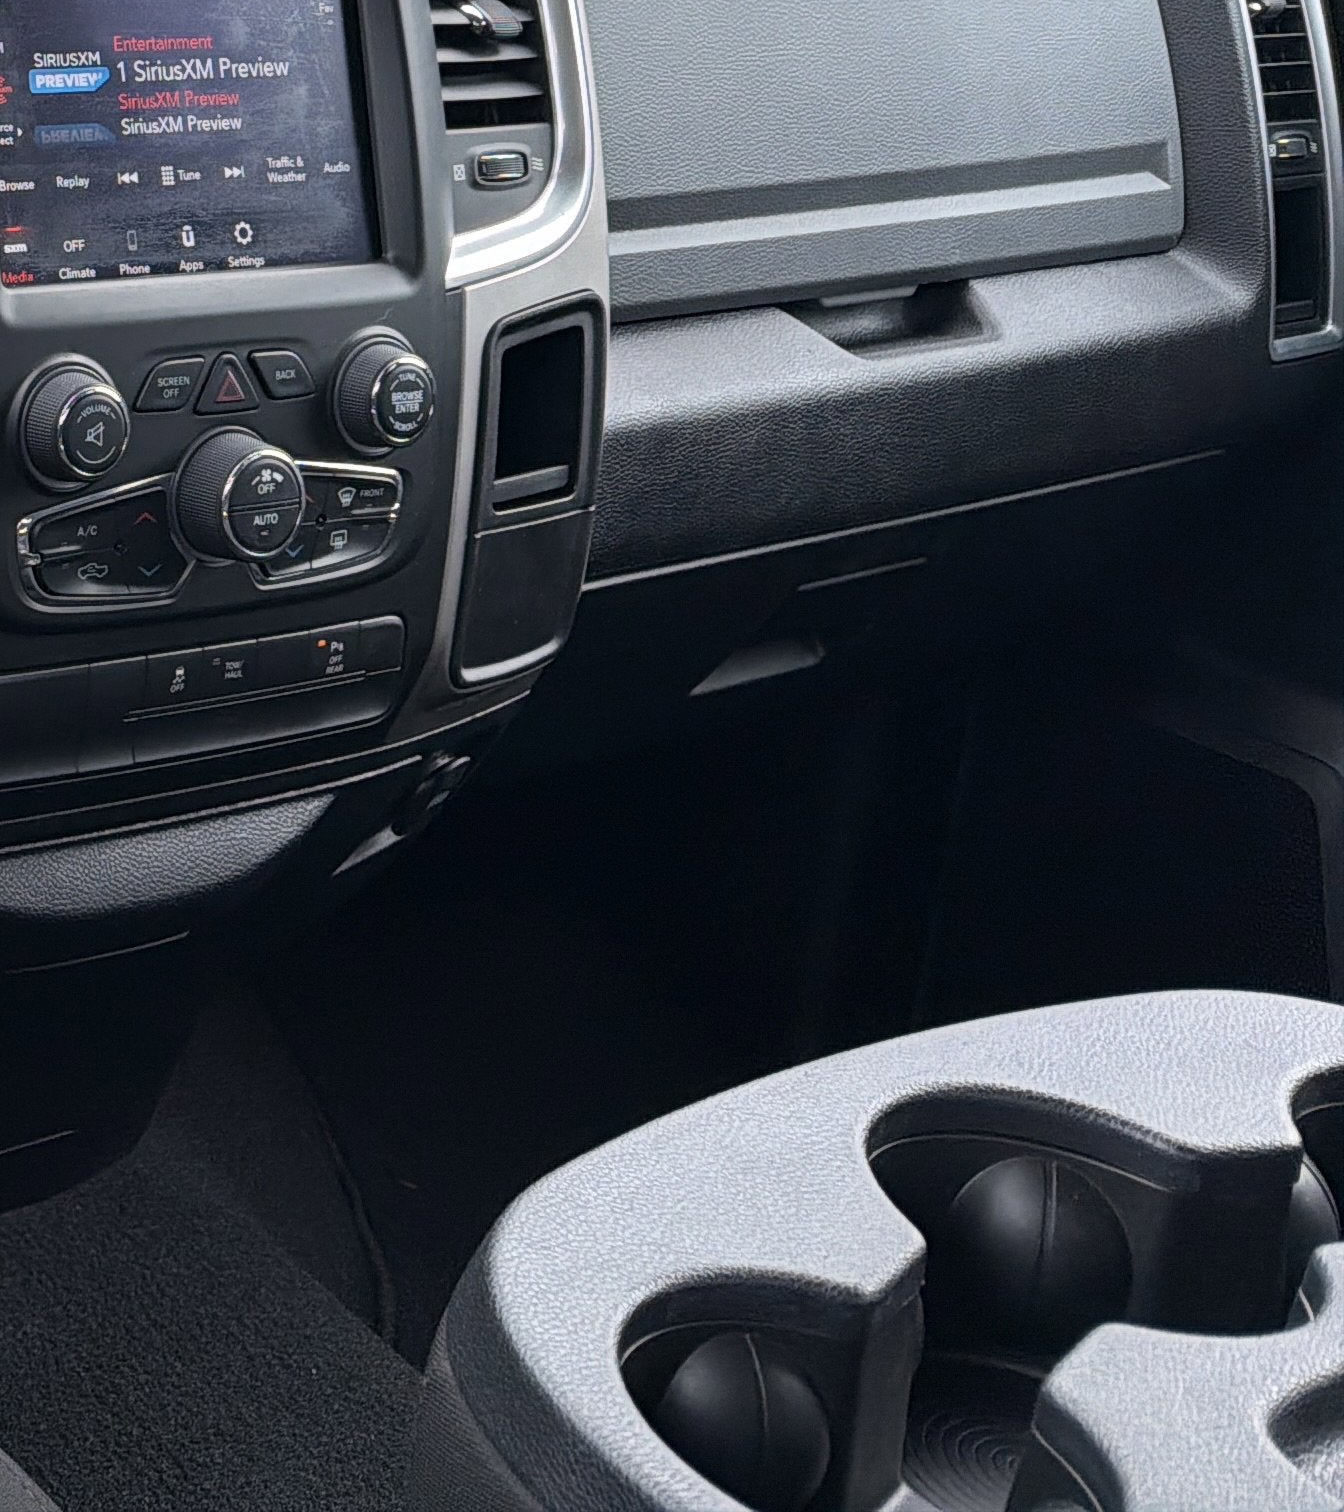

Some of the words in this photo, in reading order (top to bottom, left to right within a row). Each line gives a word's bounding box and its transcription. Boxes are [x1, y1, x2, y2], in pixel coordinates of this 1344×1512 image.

[113, 36, 213, 52] Entertainment
[33, 51, 101, 68] SIRIUSXM
[116, 61, 127, 83] 1
[133, 59, 214, 83] SiriusXM
[218, 56, 290, 79] Preview
[35, 72, 103, 89] PREVIEW
[118, 91, 180, 110] SiriusXM
[184, 89, 241, 107] Preview
[120, 115, 184, 136] SiriusXM
[187, 113, 242, 132] Preview
[265, 156, 295, 169] Traffic
[296, 156, 305, 168] &
[323, 161, 351, 173] Audio
[177, 169, 202, 181] Tune
[266, 171, 307, 183] Weather
[55, 175, 90, 189] Replay
[63, 239, 85, 252] OFF
[119, 263, 151, 275] Phone
[179, 259, 205, 272] Apps
[227, 256, 265, 269] Settings
[2, 270, 34, 284] Media
[59, 266, 97, 280] Climate
[157, 375, 190, 387] SCREEN
[275, 369, 296, 380] BACK
[162, 388, 180, 399] OFF
[391, 389, 424, 402] BROWSE
[80, 403, 112, 418] VOLUME
[395, 402, 420, 414] ENTER
[257, 482, 276, 495] OFF
[360, 487, 385, 498] FRONT
[252, 512, 279, 526] AUTO
[76, 525, 98, 537] A/C
[329, 654, 344, 664] OFF
[169, 683, 185, 694] OFF
